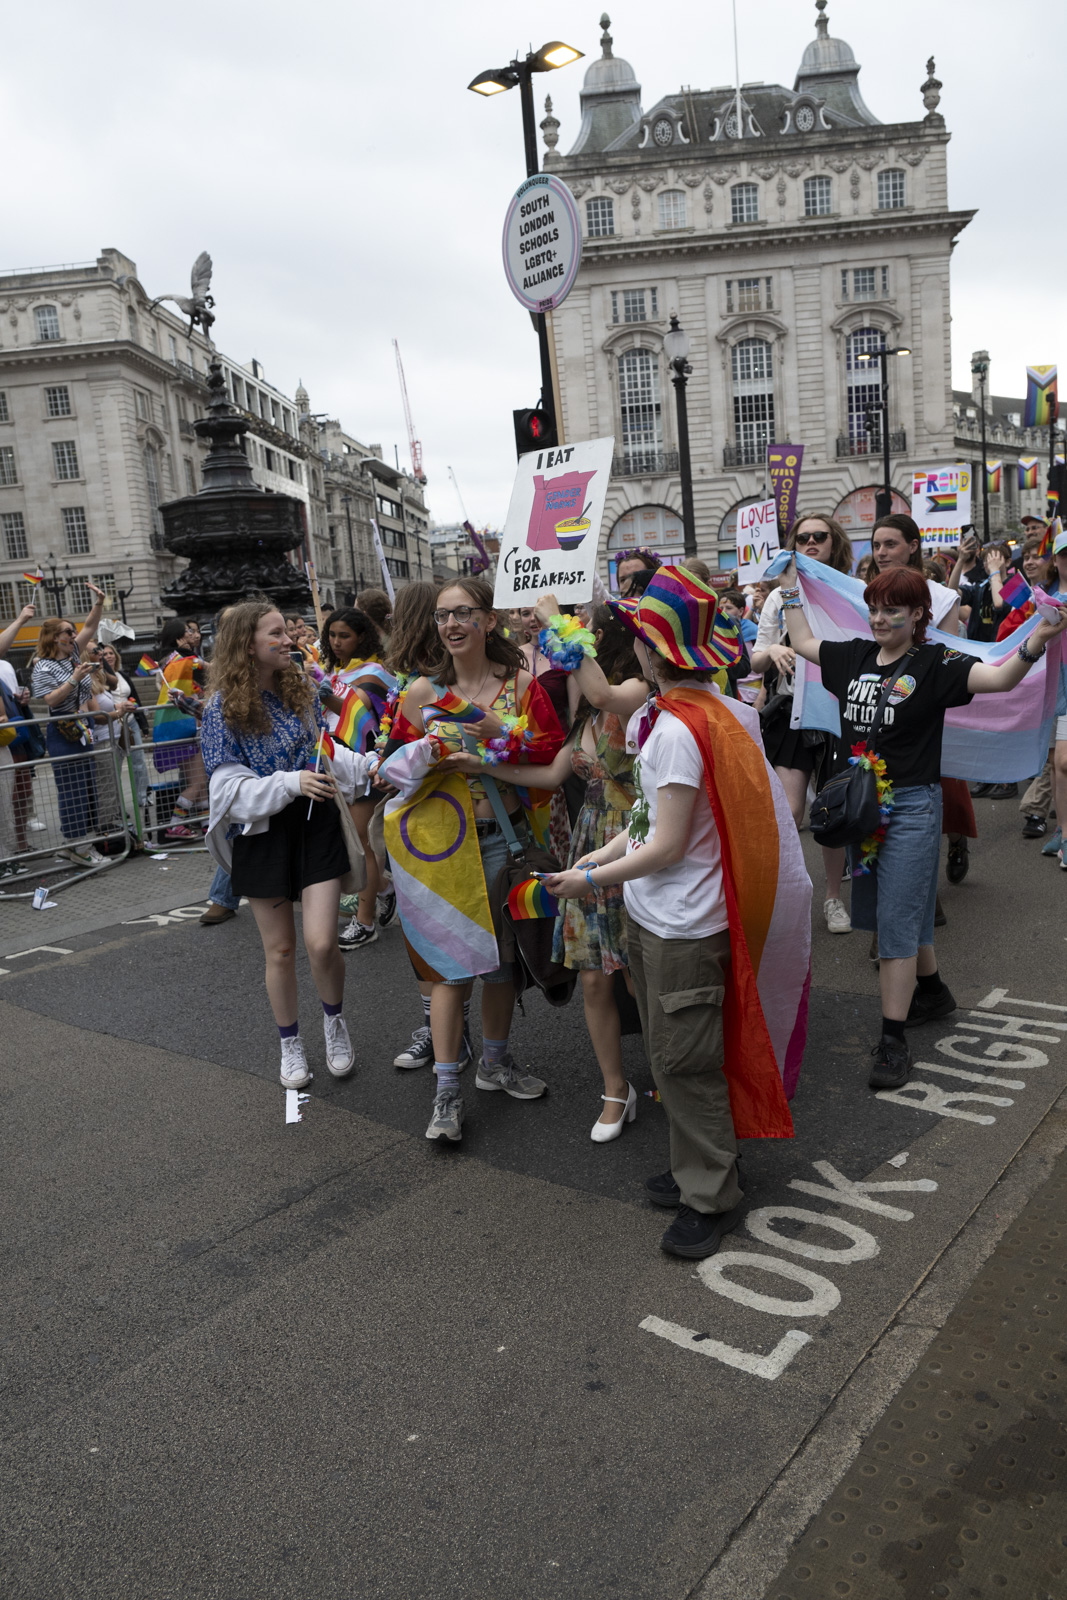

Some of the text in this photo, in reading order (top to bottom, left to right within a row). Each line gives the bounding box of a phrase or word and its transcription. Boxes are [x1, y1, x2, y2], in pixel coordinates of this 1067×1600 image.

[516, 176, 549, 198] VOLUNQUEER
[520, 194, 550, 218] SOUTH
[519, 211, 555, 237] LONDON
[519, 228, 560, 255] SCHOOLS
[524, 249, 558, 271] LGBTQ+
[522, 263, 565, 290] ALLIANCE
[536, 447, 575, 470] I EAT
[545, 487, 581, 501] GENDER
[913, 471, 970, 494] PROUD
[545, 498, 576, 512] NORMS
[741, 502, 775, 530] LOVE
[750, 526, 761, 539] IS
[737, 540, 779, 567] LOVE
[514, 556, 541, 576] FOR
[513, 570, 586, 592] BREAKFAST.
[638, 988, 1067, 1381] LOOK RIGHT
